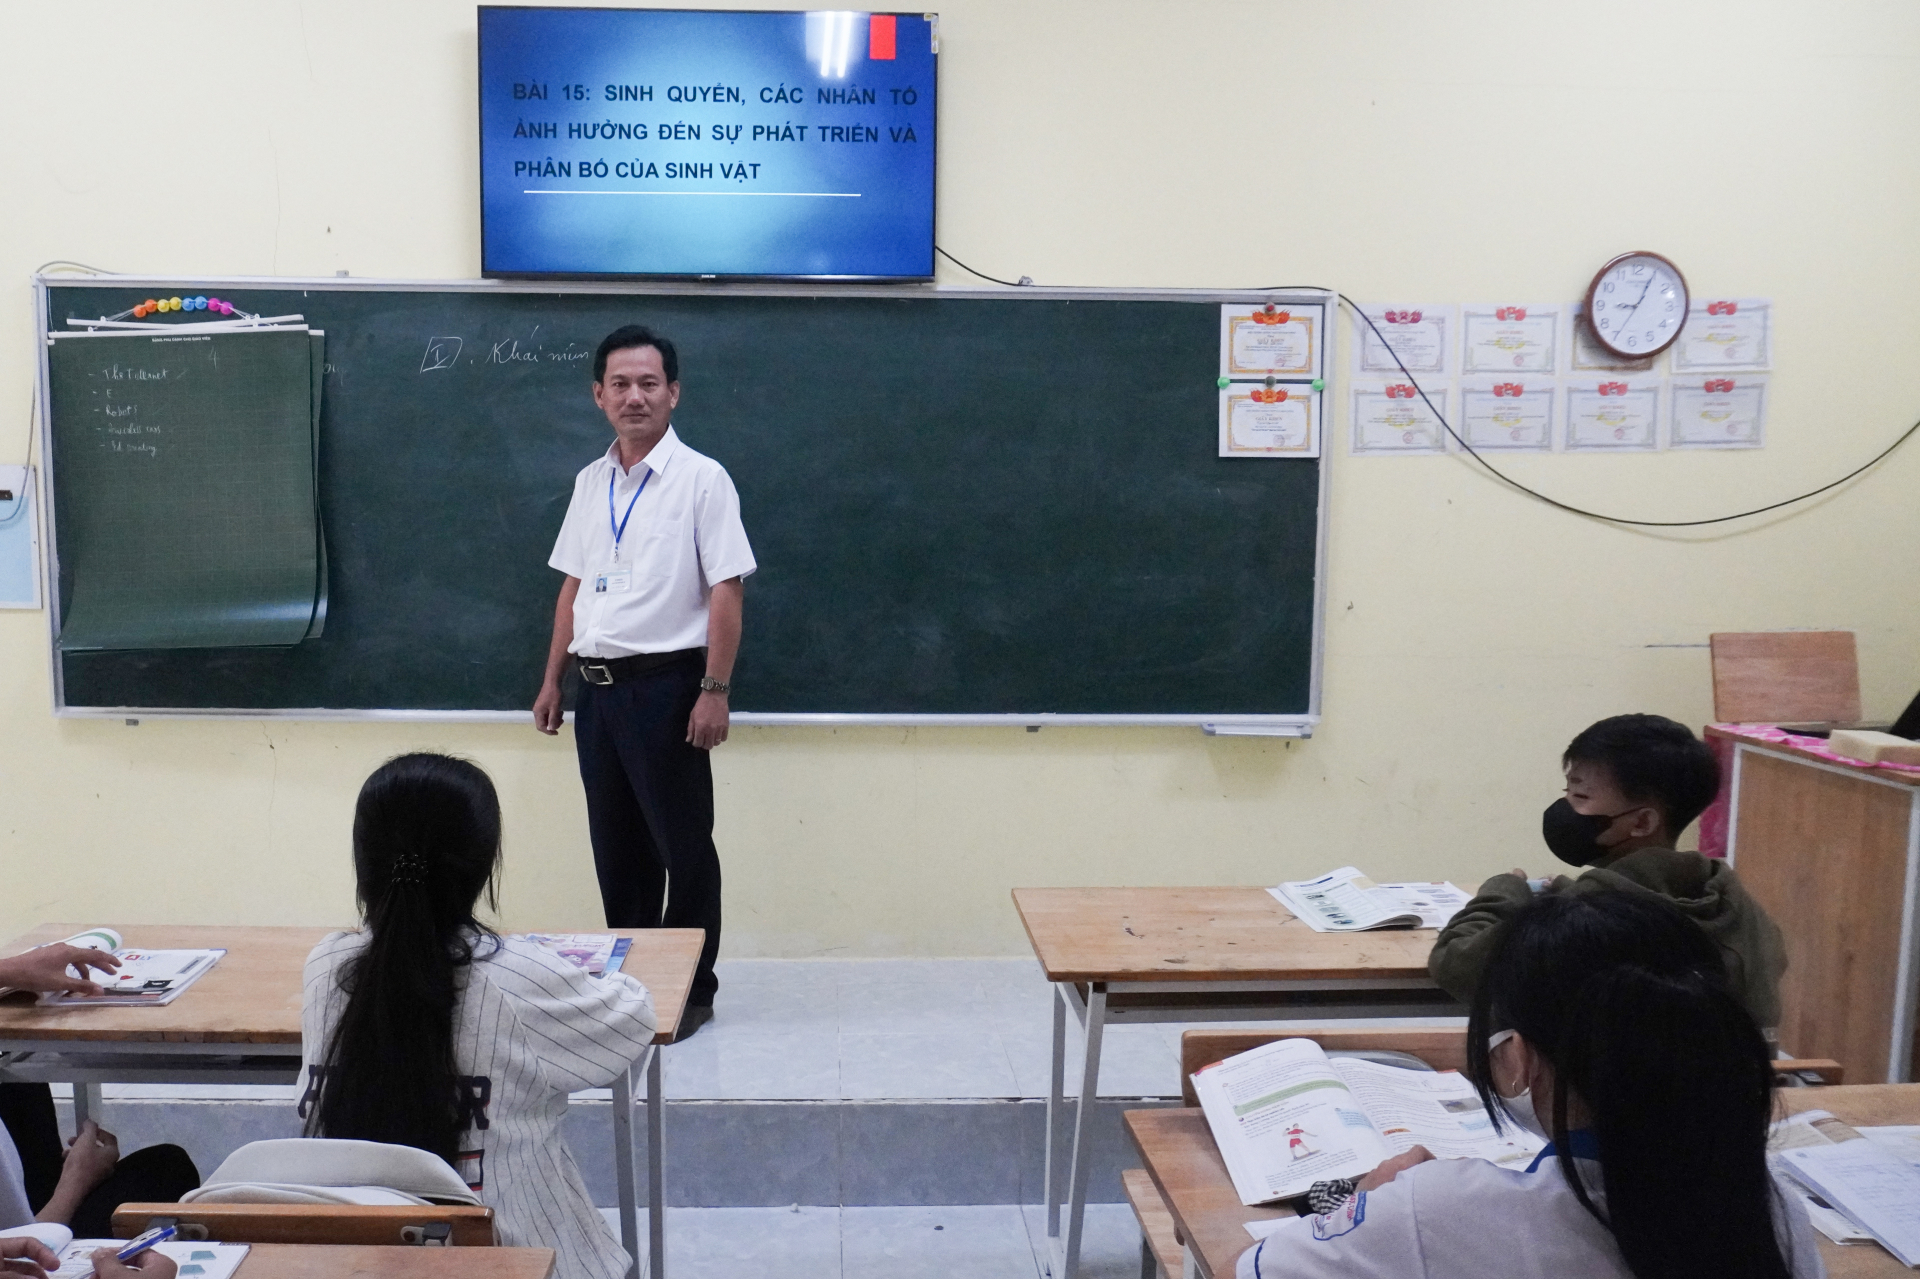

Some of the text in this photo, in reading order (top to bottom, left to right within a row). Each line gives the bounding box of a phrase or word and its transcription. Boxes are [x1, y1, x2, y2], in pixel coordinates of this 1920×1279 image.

[513, 79, 548, 101] BÀI
[562, 84, 590, 101] 15:
[604, 84, 653, 102] SINH
[759, 83, 804, 104] CÁC
[817, 84, 876, 105] NHÂN
[568, 118, 648, 140] HƯỞNG
[657, 120, 701, 141] ĐẾN
[712, 124, 743, 145] SỰ
[752, 121, 808, 142] PHÁT
[889, 122, 917, 144] VÀ
[514, 156, 571, 178] PHÂN
[615, 158, 660, 179] CỦA
[665, 162, 713, 179] SINH
[720, 160, 761, 183] VẬT
[1632, 264, 1645, 276] 12
[1603, 281, 1615, 293] 10
[1660, 283, 1670, 294] 2
[1596, 300, 1605, 311] 9
[1665, 301, 1674, 312] 3
[1601, 318, 1609, 329] 8
[1658, 319, 1667, 329] 4
[1612, 331, 1620, 341] 7
[1628, 336, 1637, 347] 6
[1646, 331, 1655, 342] 5
